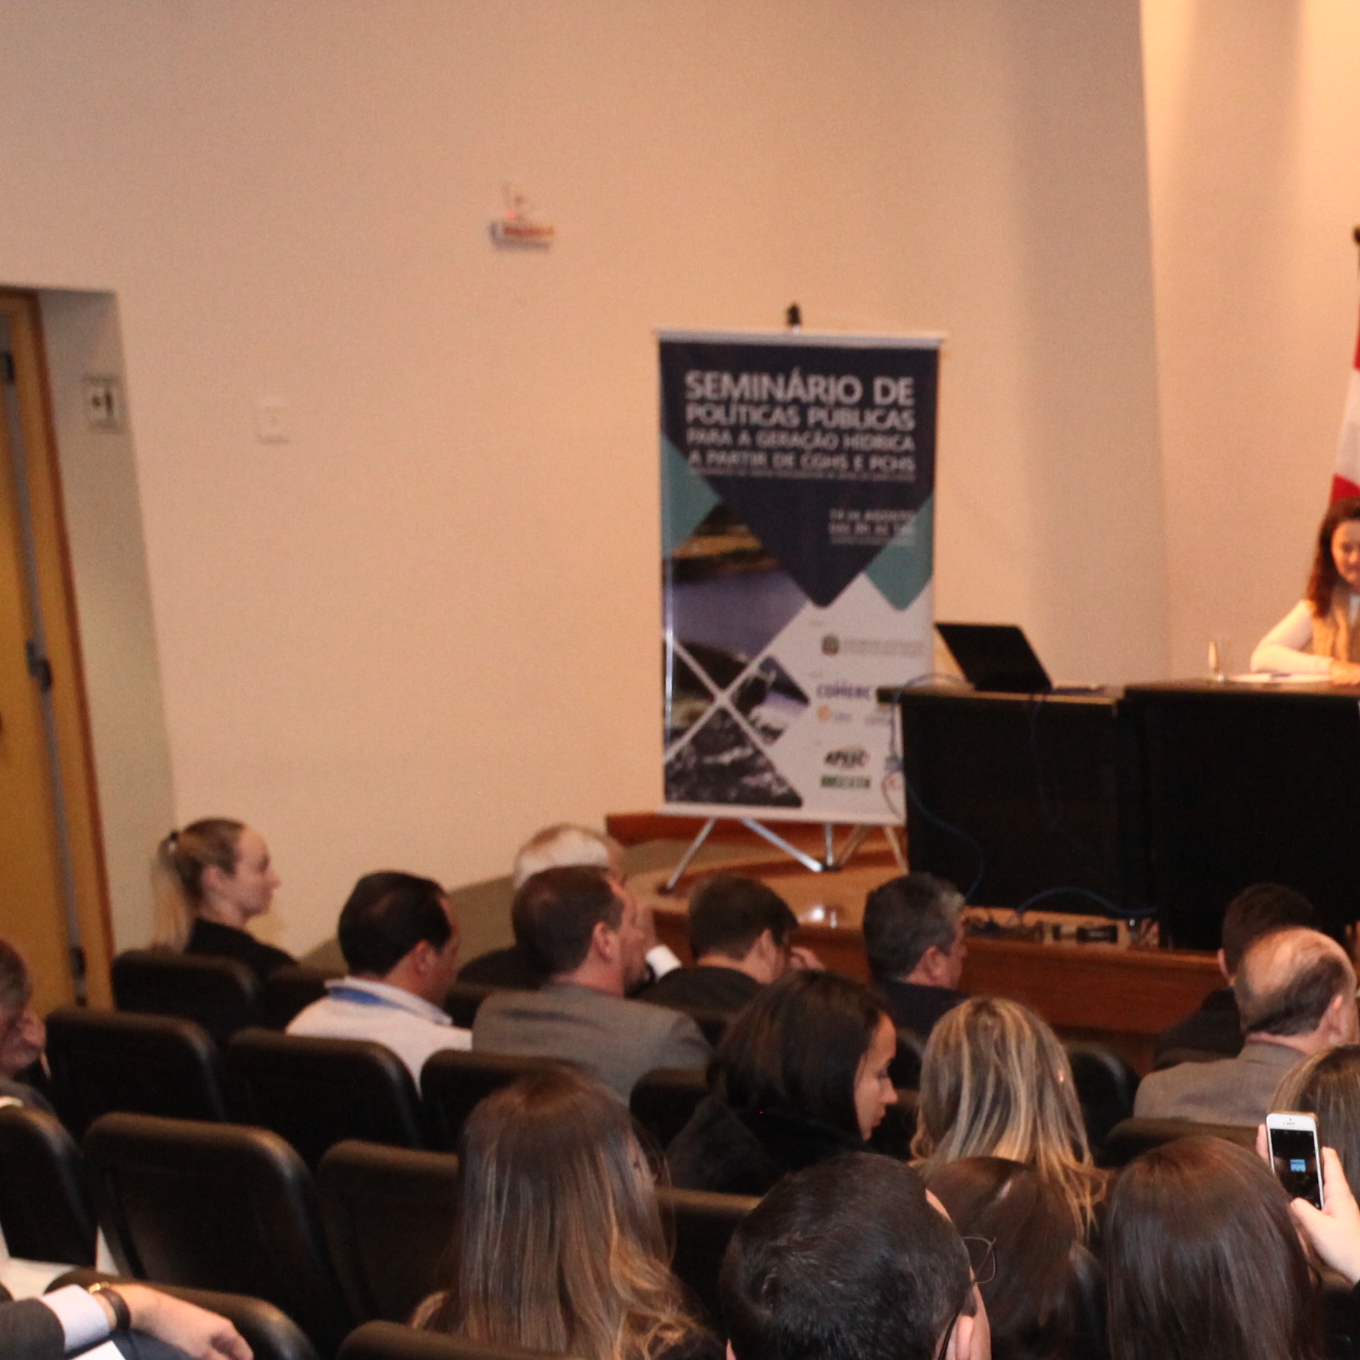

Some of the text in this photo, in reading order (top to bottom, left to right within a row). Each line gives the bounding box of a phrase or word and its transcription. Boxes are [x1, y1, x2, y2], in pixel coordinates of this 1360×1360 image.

[685, 367, 915, 406] SEMINÁRIO DE
[686, 401, 800, 427] POLÍTICAS
[686, 427, 733, 446] PARA
[737, 429, 751, 446] A
[689, 450, 702, 467] A
